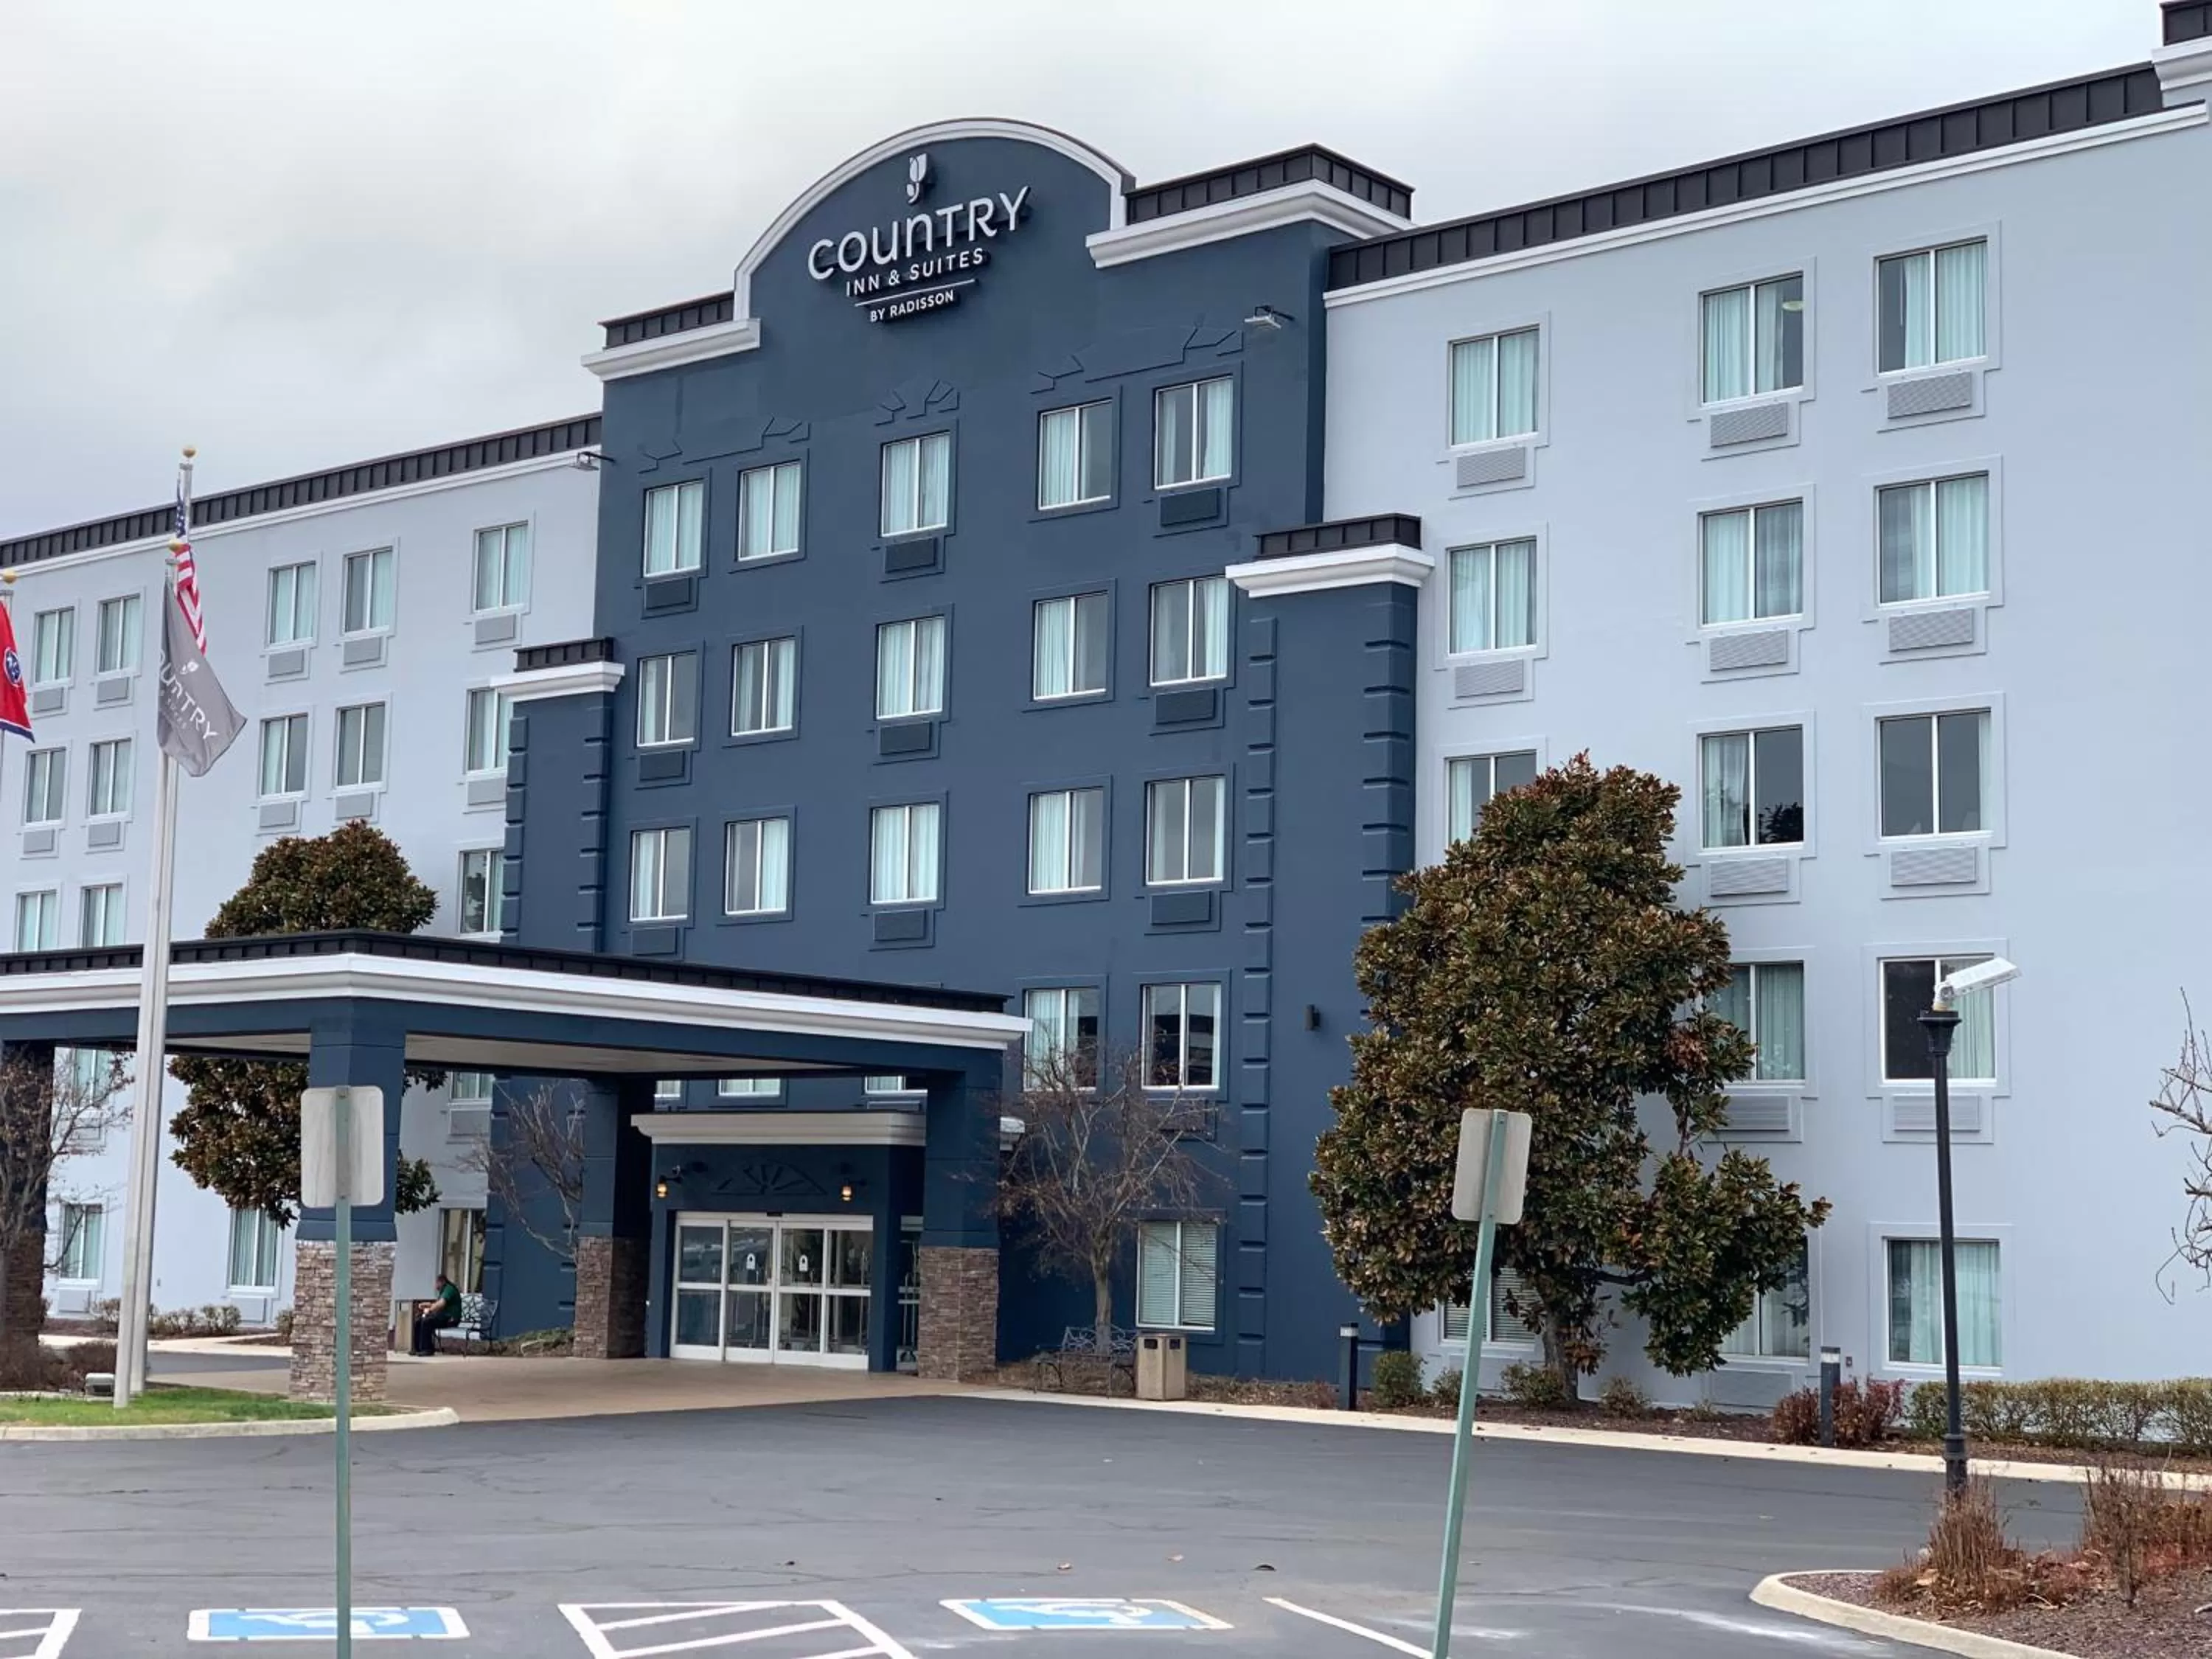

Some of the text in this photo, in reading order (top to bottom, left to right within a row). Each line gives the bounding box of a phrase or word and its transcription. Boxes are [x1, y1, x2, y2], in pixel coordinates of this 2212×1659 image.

[808, 185, 1031, 279] COUNTRY
[846, 248, 984, 296] INN & SUITES
[870, 290, 954, 322] BY RADISSON
[159, 648, 220, 740] UNTRY
